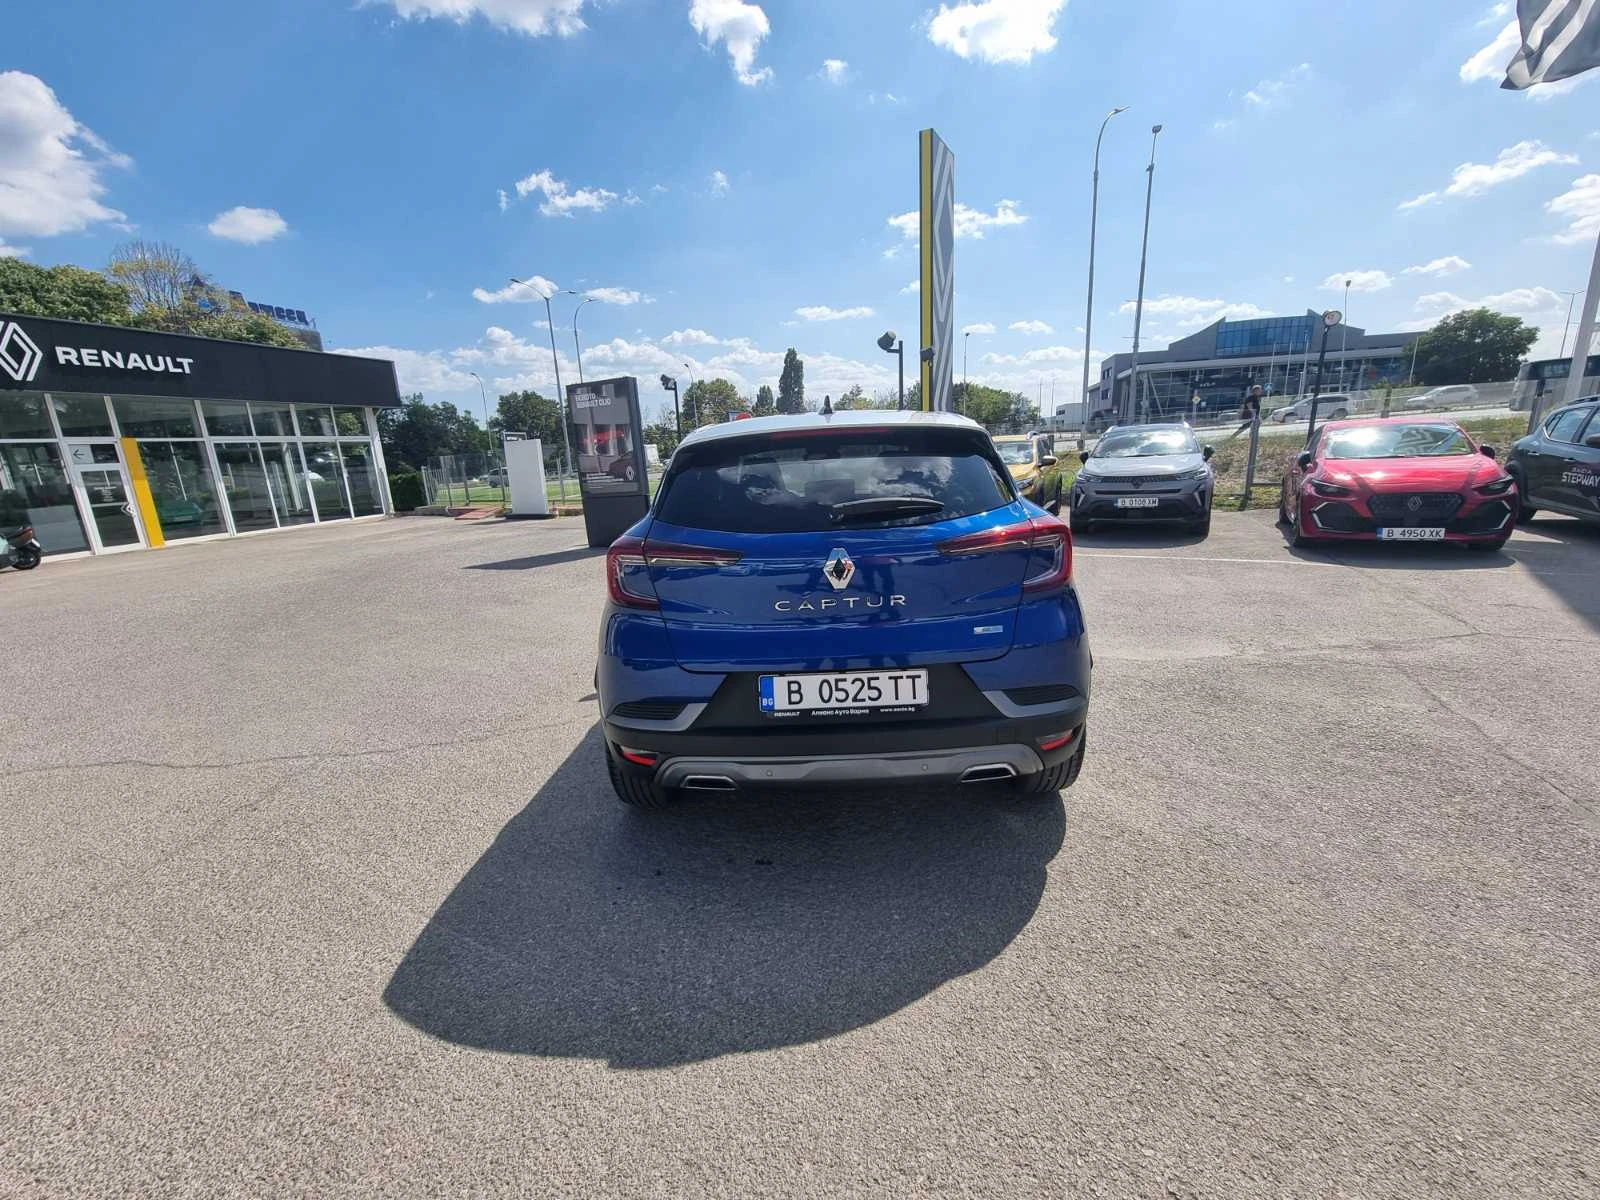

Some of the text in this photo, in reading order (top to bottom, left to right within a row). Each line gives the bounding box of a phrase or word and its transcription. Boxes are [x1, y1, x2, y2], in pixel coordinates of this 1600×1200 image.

[55, 346, 194, 374] RENAULT
[1561, 471, 1600, 487] STEPWAY
[1387, 529, 1394, 537] B
[1400, 529, 1426, 537] 4950
[775, 594, 907, 611] CAPTUR
[762, 675, 922, 706] BG B 0525 TT
